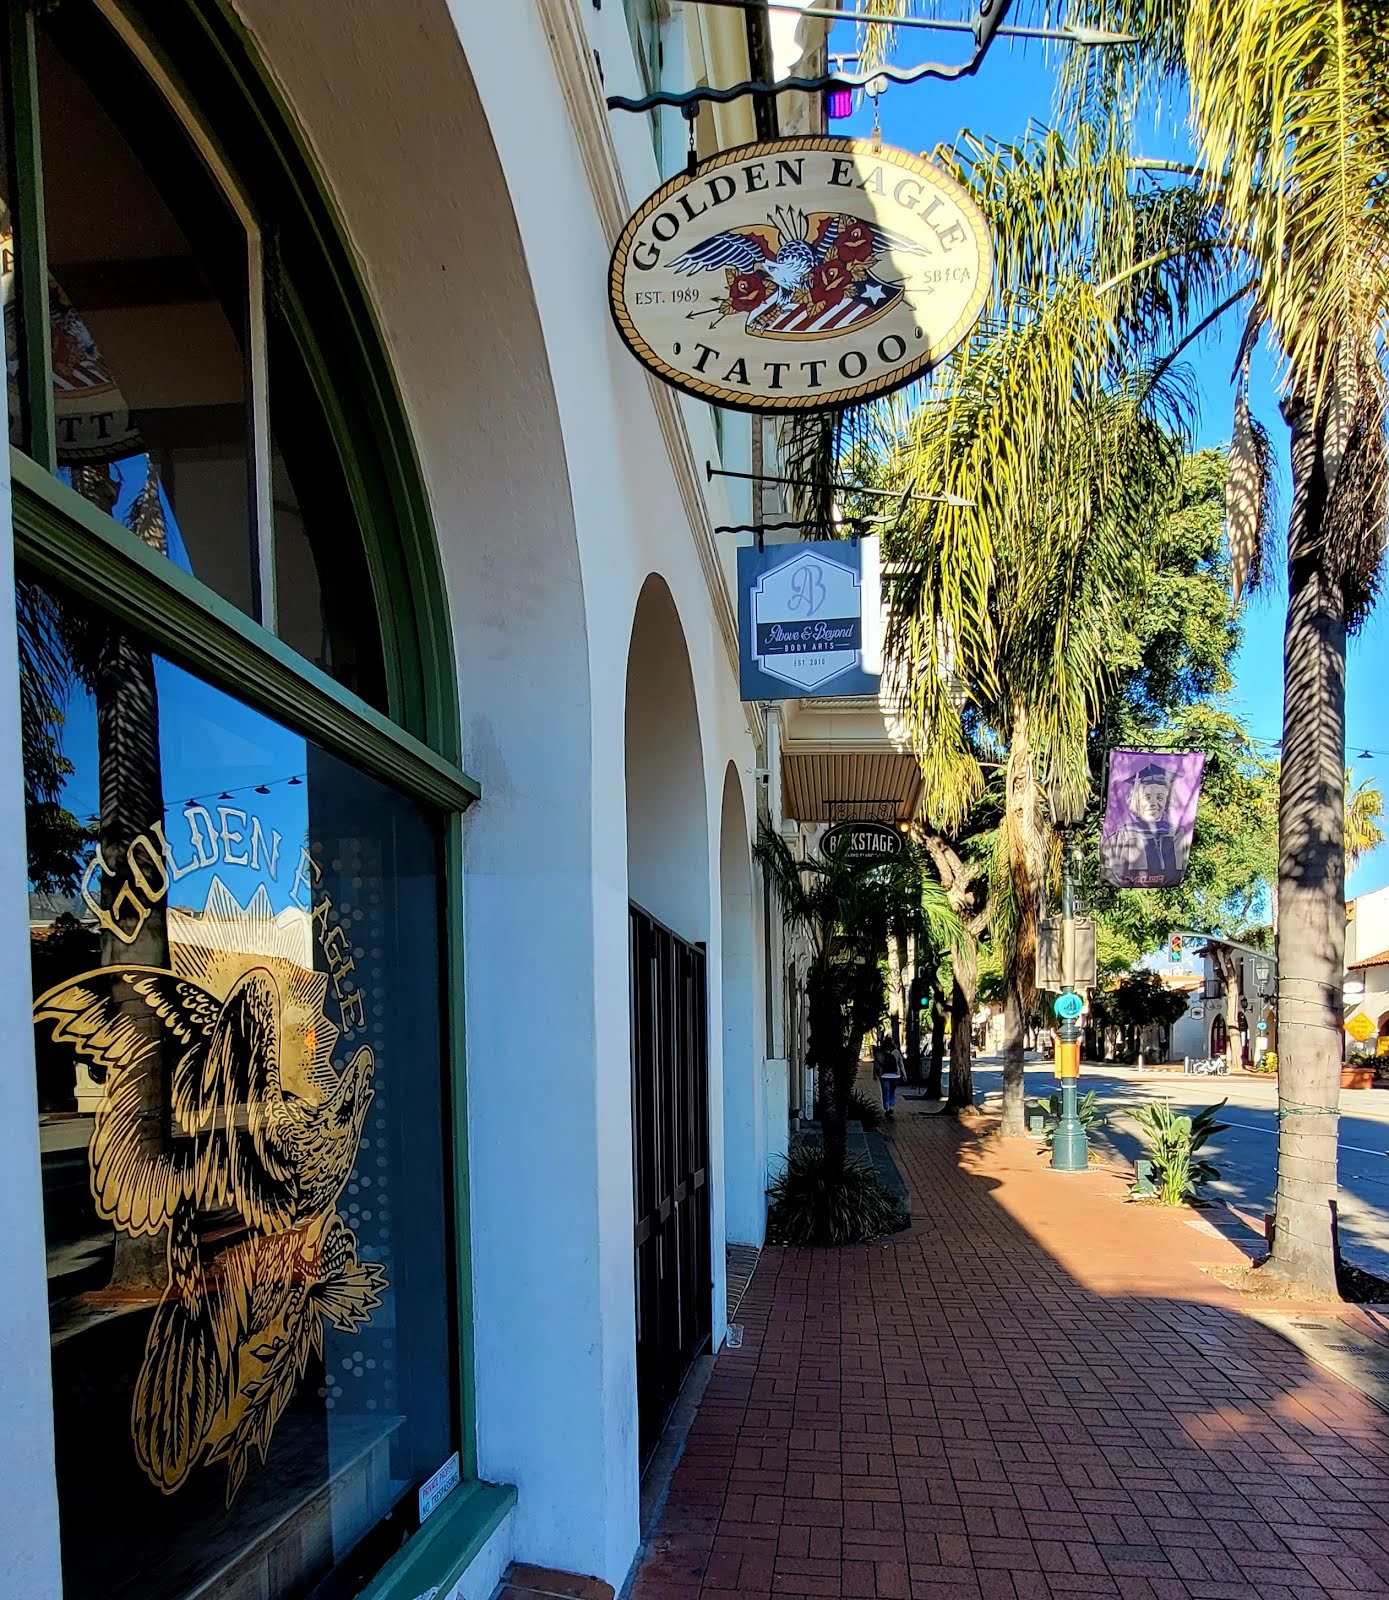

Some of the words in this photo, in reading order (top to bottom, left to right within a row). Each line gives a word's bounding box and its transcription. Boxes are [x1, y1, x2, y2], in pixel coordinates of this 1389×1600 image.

[632, 158, 806, 271] GOLDEN
[828, 157, 967, 253] EAGLE
[635, 291, 666, 305] EST.
[671, 288, 700, 303] 1989
[692, 335, 907, 389] TATTOO
[765, 624, 800, 645] Above
[800, 626, 813, 641] &
[812, 622, 854, 641] Beyond
[784, 644, 807, 652] BODY
[812, 642, 835, 650] ARTS
[810, 658, 826, 666] 2010
[830, 833, 894, 854] BKSTAGE
[81, 805, 283, 945] GOLDEN
[289, 846, 366, 1034] EAGLE
